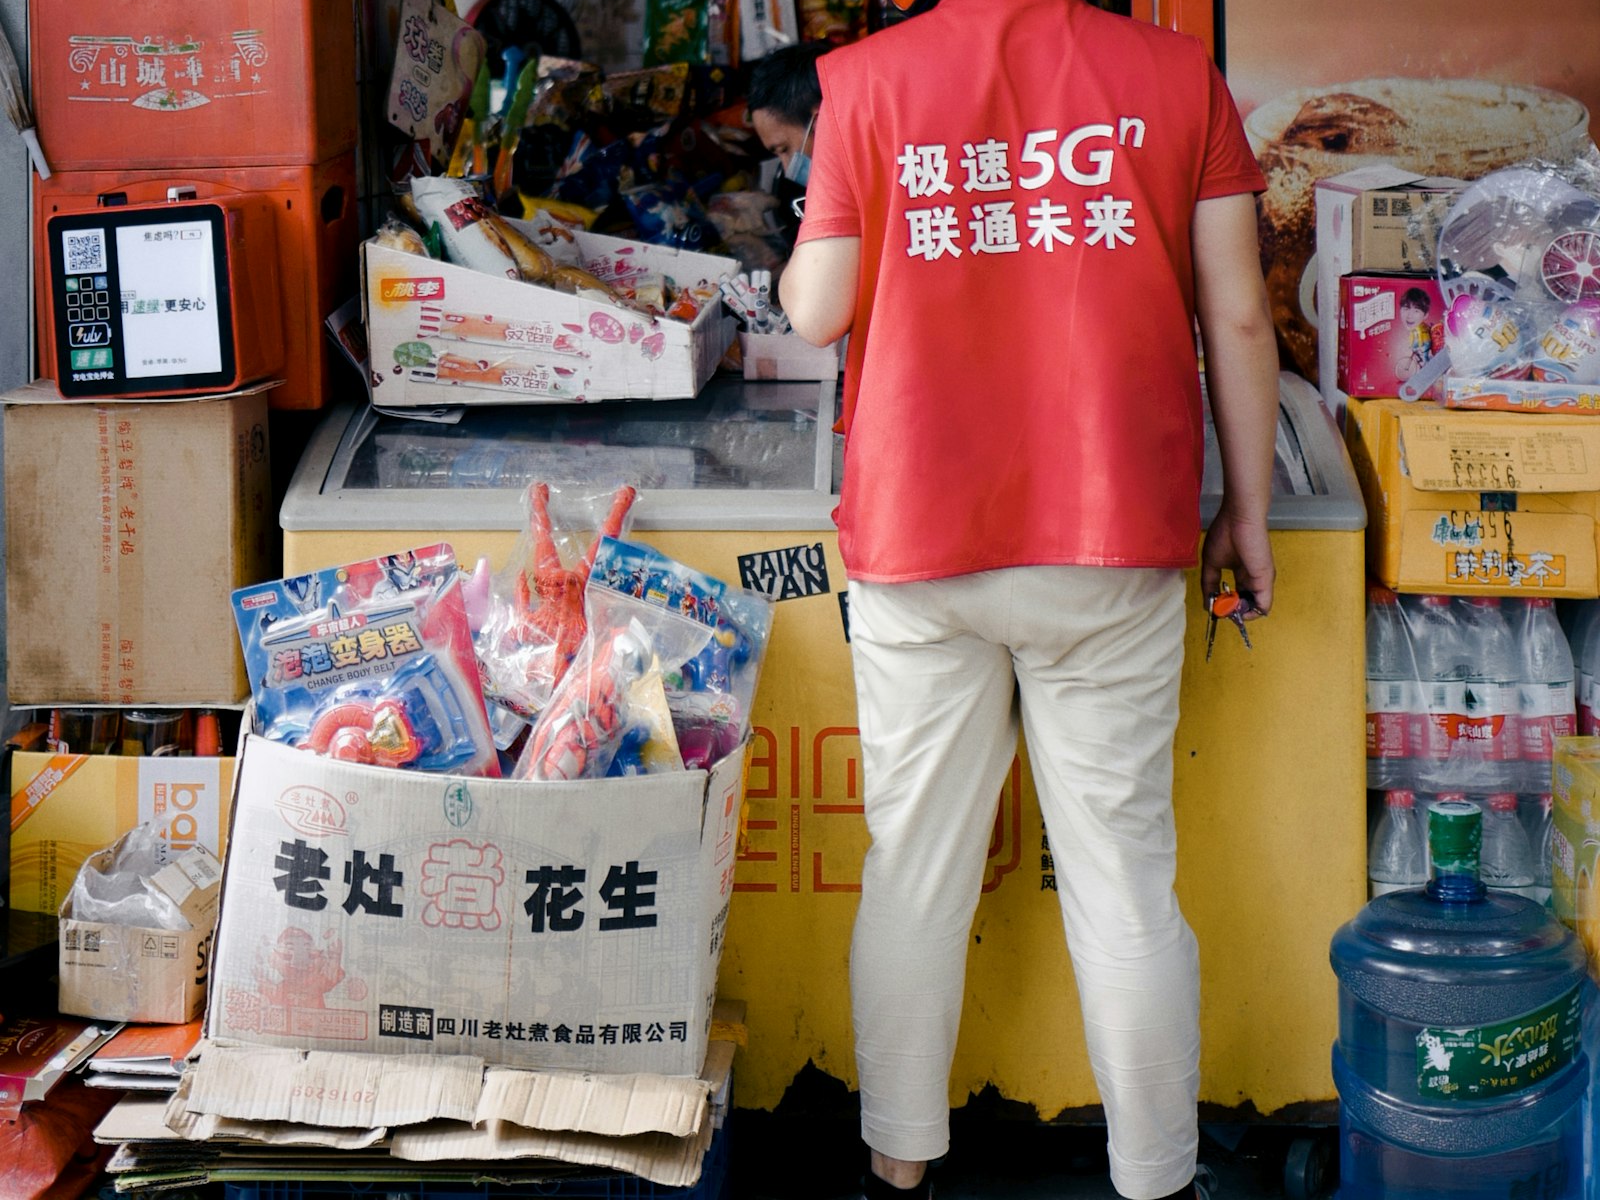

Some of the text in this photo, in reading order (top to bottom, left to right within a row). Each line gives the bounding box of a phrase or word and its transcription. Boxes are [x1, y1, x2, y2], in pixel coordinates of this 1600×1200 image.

[905, 194, 1136, 261] 联通未来
[164, 298, 206, 313] 更安心
[119, 506, 135, 555] 老干妈
[273, 622, 423, 682] 泡泡变身器
[307, 661, 396, 690] CHANGE BODY BELT
[381, 1008, 433, 1037] 制造商
[436, 1017, 689, 1045] 四川老灶煮食品有限公司
[1479, 1013, 1558, 1066] 放心水
